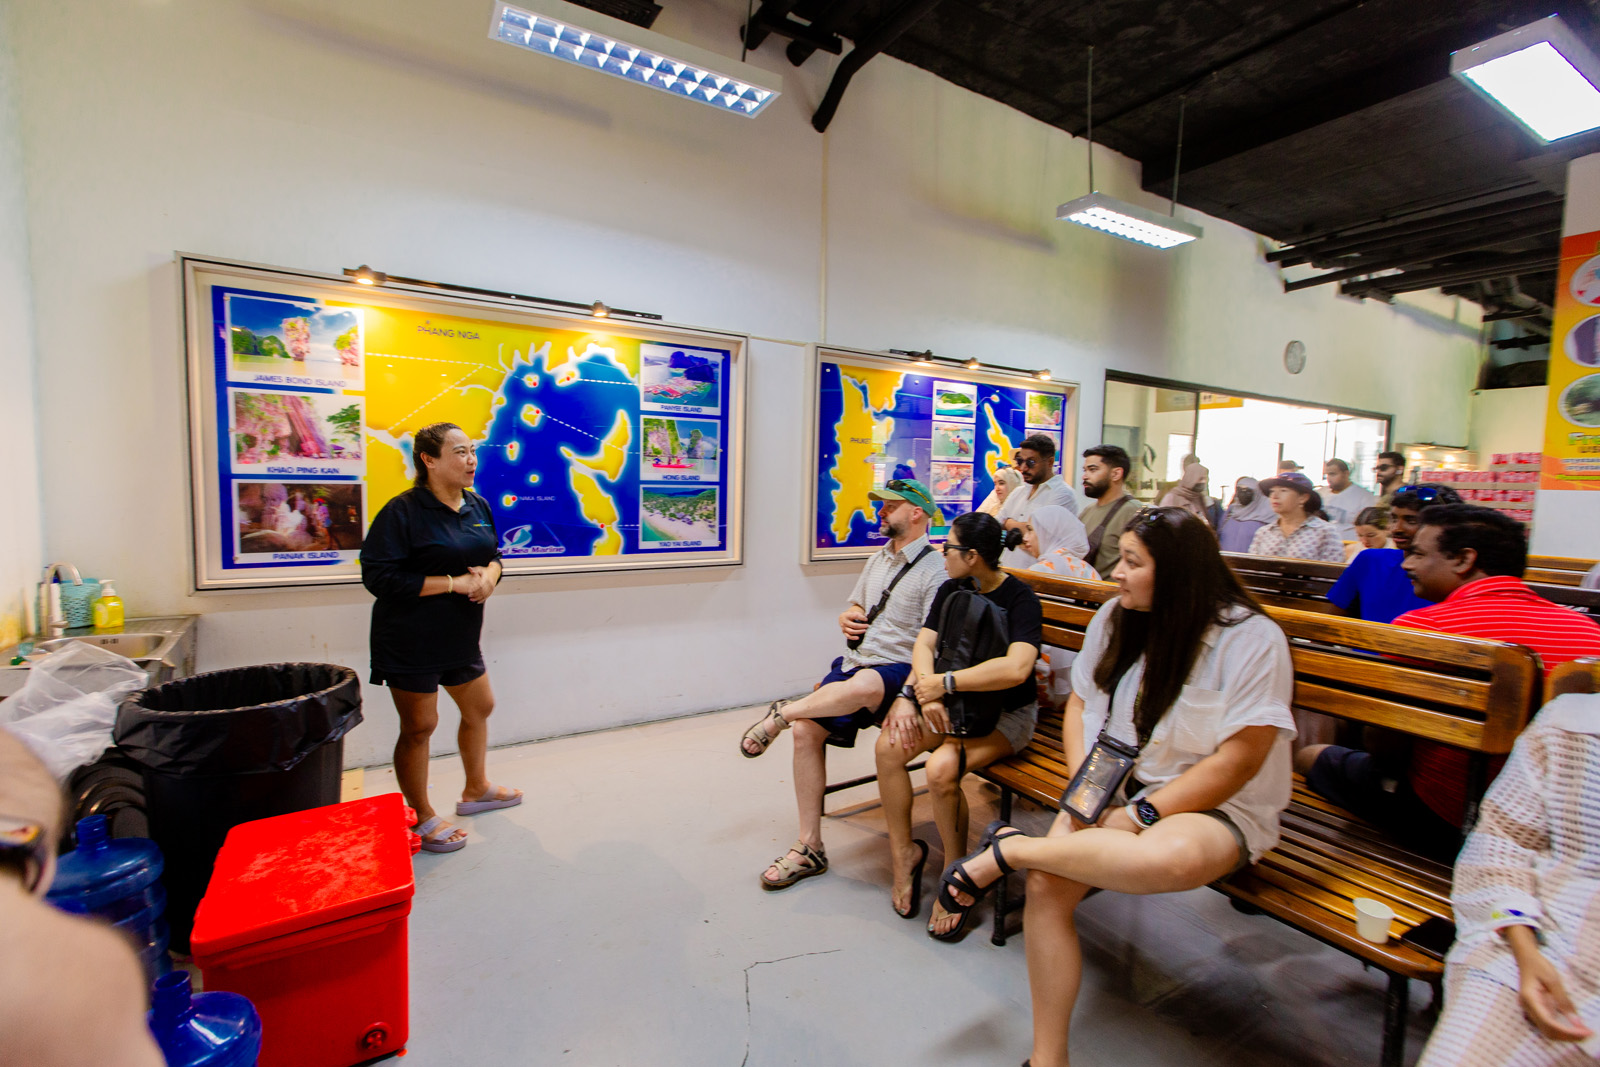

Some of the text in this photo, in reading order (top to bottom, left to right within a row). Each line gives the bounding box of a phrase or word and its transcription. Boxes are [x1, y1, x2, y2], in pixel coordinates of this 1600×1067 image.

[417, 325, 480, 340] PHANG NGA
[254, 374, 346, 388] JAMES BOND ISLAND
[850, 437, 872, 445] PHUKET
[267, 466, 340, 475] KHAO PING KAN
[511, 546, 529, 554] Sea
[307, 551, 340, 559] ISLAND
